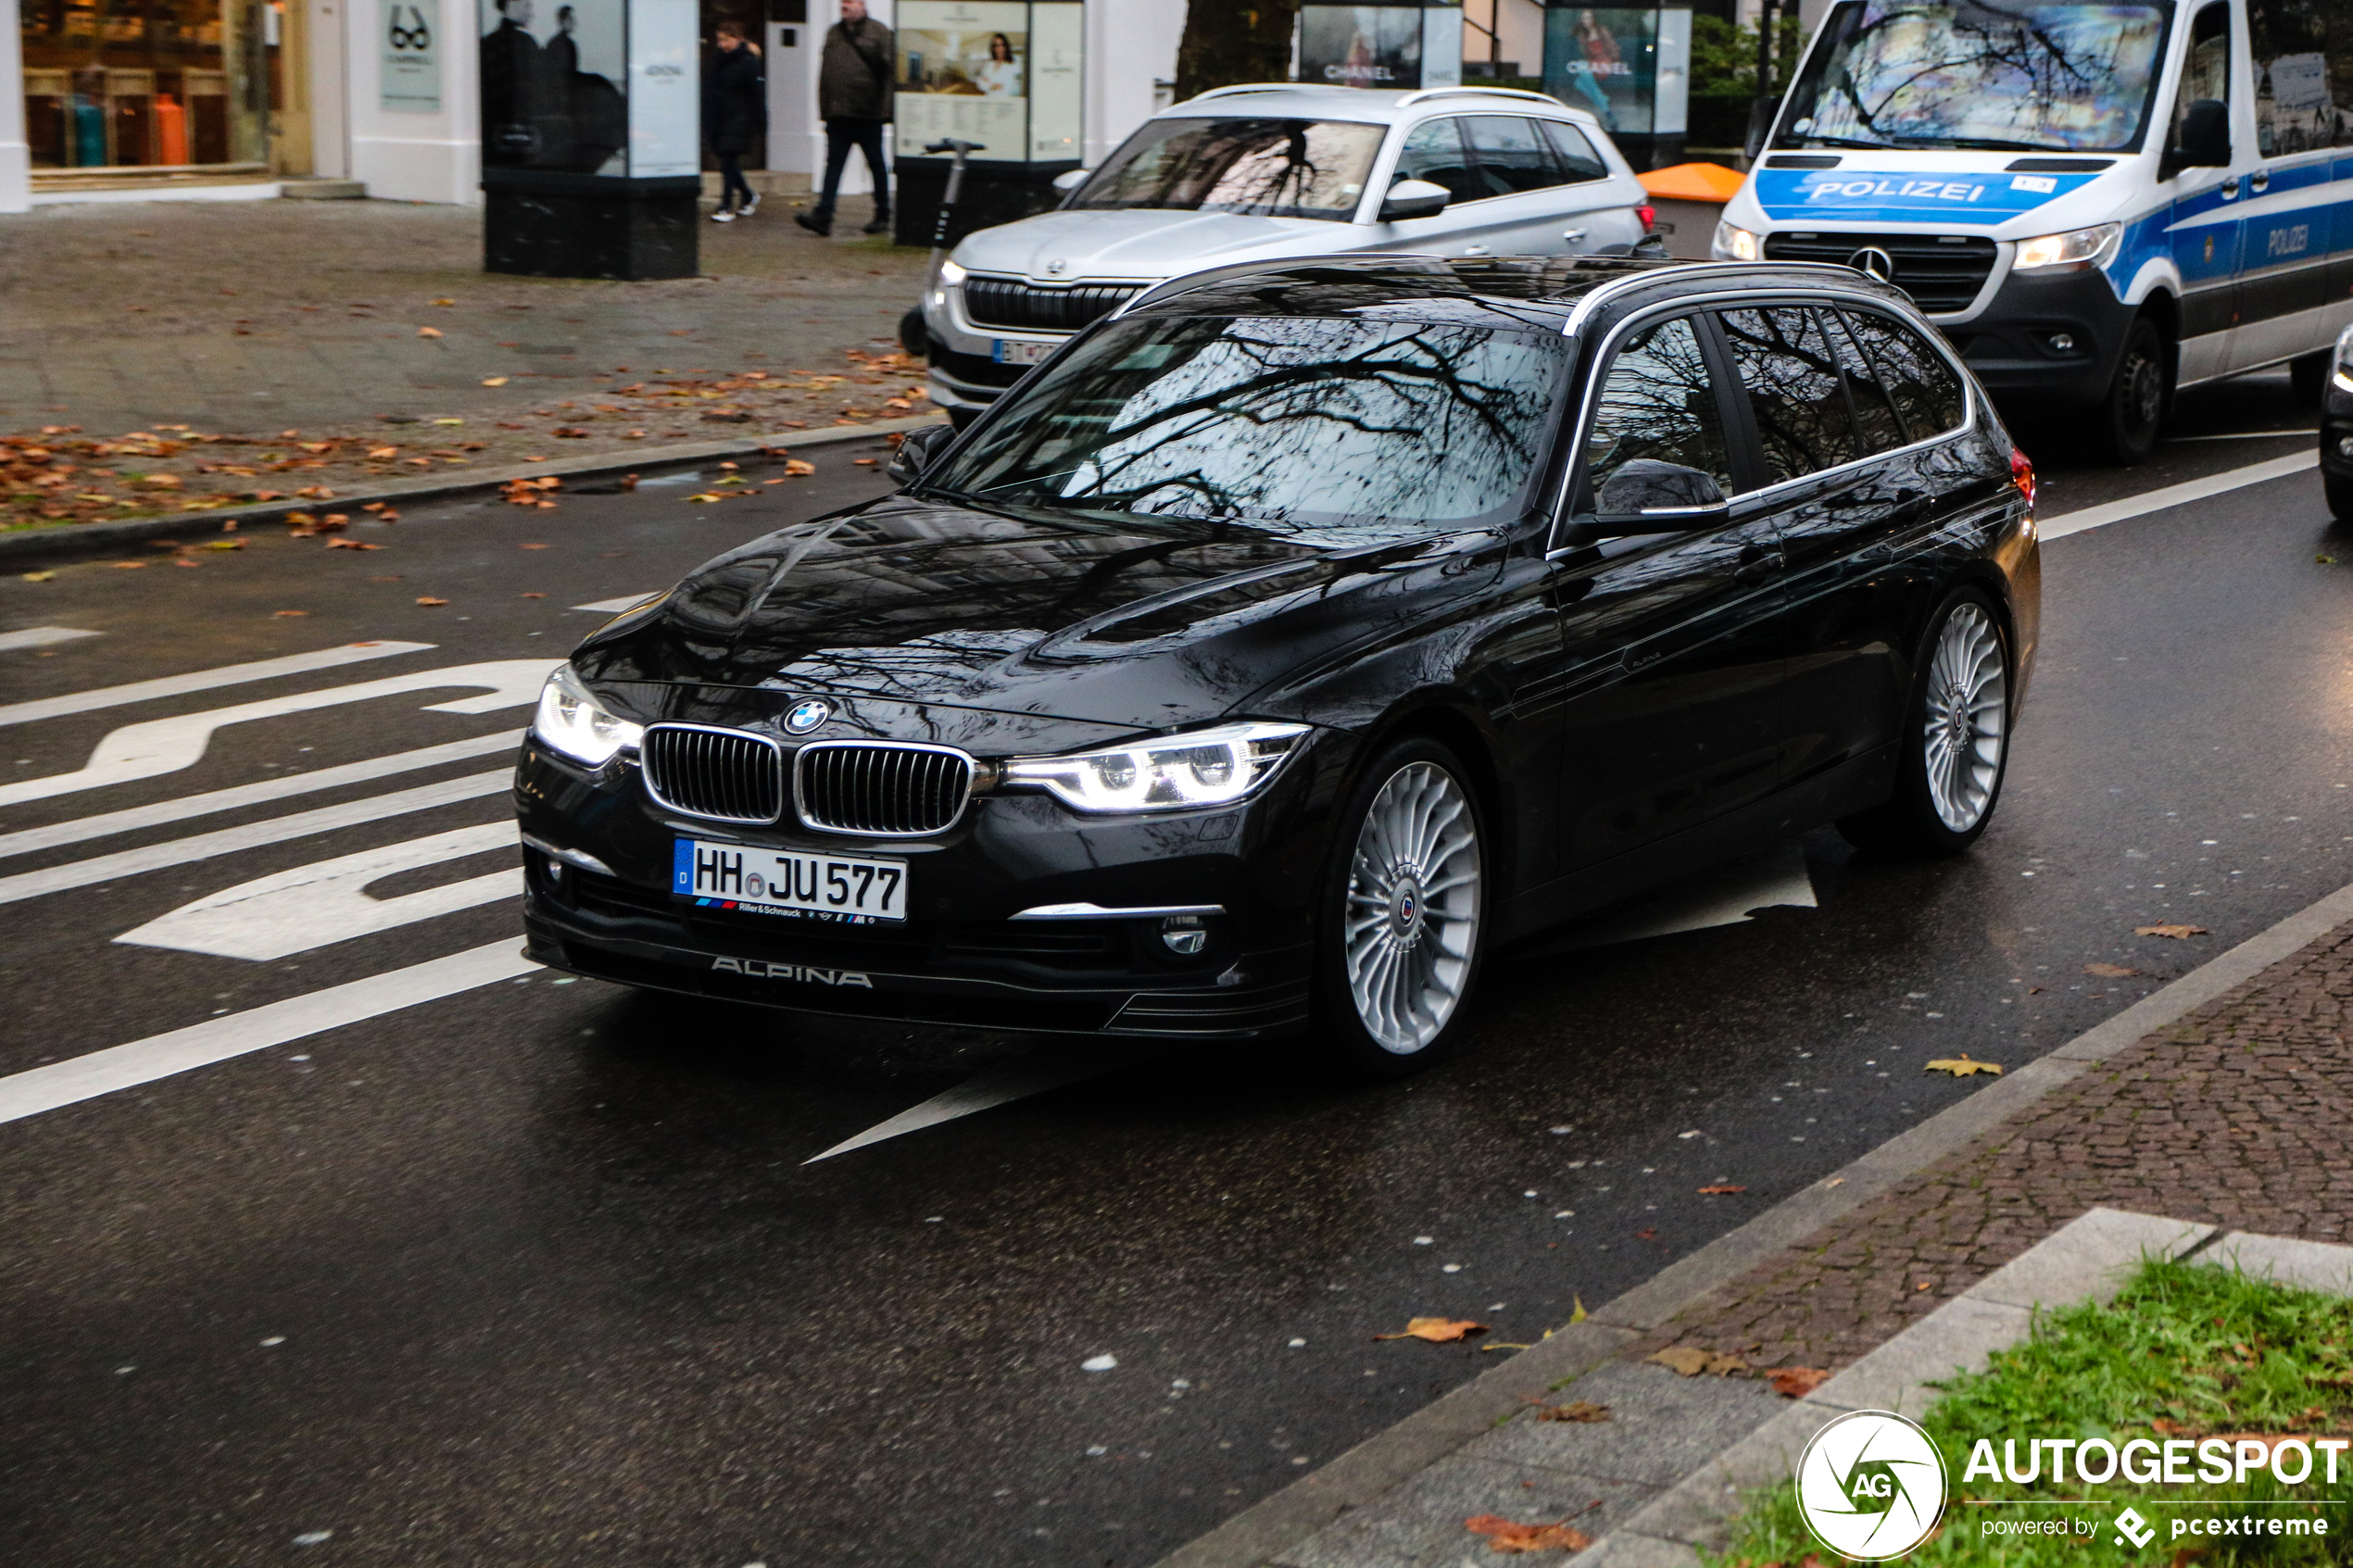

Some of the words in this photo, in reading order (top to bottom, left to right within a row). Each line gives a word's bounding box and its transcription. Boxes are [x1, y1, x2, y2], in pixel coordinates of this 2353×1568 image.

[1324, 65, 1396, 81] CHANEL
[1566, 59, 1632, 75] CHANEL
[1809, 181, 1985, 202] POLIZEI
[2267, 224, 2310, 257] POLIZEI
[1632, 652, 1661, 667] ALPINA
[679, 872, 687, 884] D
[696, 847, 742, 895] HH
[768, 857, 817, 902] JU
[826, 862, 900, 911] 577
[711, 956, 874, 989] ALPINA
